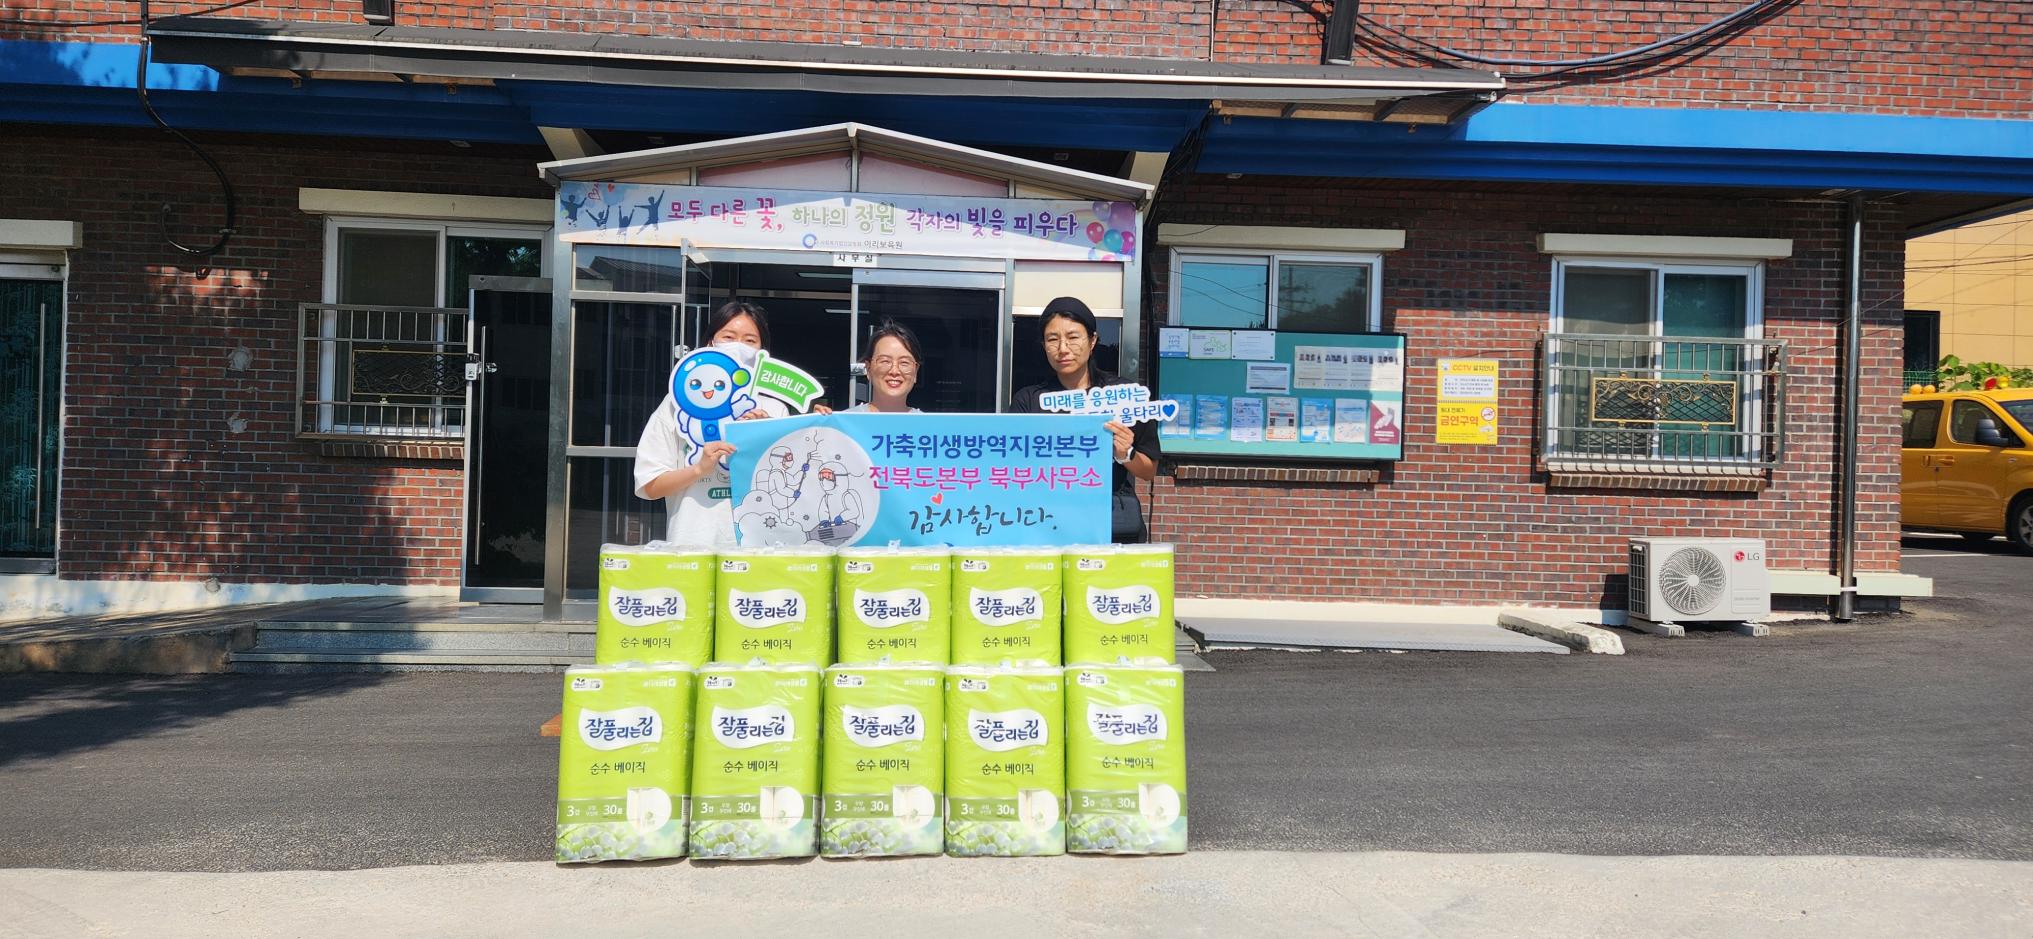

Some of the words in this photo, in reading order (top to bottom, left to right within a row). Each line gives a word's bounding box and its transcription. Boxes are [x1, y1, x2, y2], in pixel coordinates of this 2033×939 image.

[667, 200, 703, 222] 모두
[710, 199, 747, 225] 다른
[756, 197, 783, 231] 꽃,
[792, 207, 847, 226] 하나의
[855, 202, 895, 233] 정원
[906, 208, 960, 231] 각자의
[967, 207, 1005, 237] 빛을
[1013, 211, 1078, 237] 피우다
[760, 369, 809, 397] 감사합니다
[1043, 393, 1085, 409] 미래를
[1090, 387, 1147, 407] 응원하는
[1120, 405, 1162, 424] 울타리
[1441, 415, 1479, 427] 금연구역
[872, 433, 1100, 459] 가축위생방역지원본부
[869, 466, 982, 490] 전북도본부
[988, 466, 1104, 490] 북부사무소
[908, 504, 1057, 536] 감사합니다.
[1747, 552, 1760, 561] LG
[615, 596, 677, 618] 잘풀리는집
[735, 598, 797, 620] 잘풀리는집
[860, 597, 921, 619] 잘풀리는집
[976, 596, 1035, 618] 잘풀리는집
[1092, 594, 1152, 616] 잘풀리는집
[620, 638, 640, 649] 순수
[642, 637, 671, 649] 베이직
[741, 639, 760, 650] 순수
[763, 639, 792, 650] 베이직
[867, 639, 886, 650] 순수
[889, 638, 917, 649] 베이직
[982, 637, 1001, 648] 순수
[1004, 636, 1031, 647] 베이직
[1100, 634, 1118, 645] 순수
[1121, 634, 1148, 645] 베이직
[585, 716, 653, 741] 잘풀리는집
[718, 715, 785, 740] 잘풀리는집
[850, 714, 915, 738] 잘풀리는집
[975, 719, 1039, 742] 잘풀리는집
[590, 763, 611, 775] 순수
[614, 762, 646, 774] 베이직
[723, 761, 744, 773] 순수
[747, 760, 778, 772] 베이직
[856, 760, 877, 772] 순수
[879, 759, 910, 771] 베이직
[982, 763, 1002, 775] 순수
[1005, 763, 1034, 775] 베이직
[1102, 756, 1121, 768] 순수
[1124, 757, 1154, 769] 베이직
